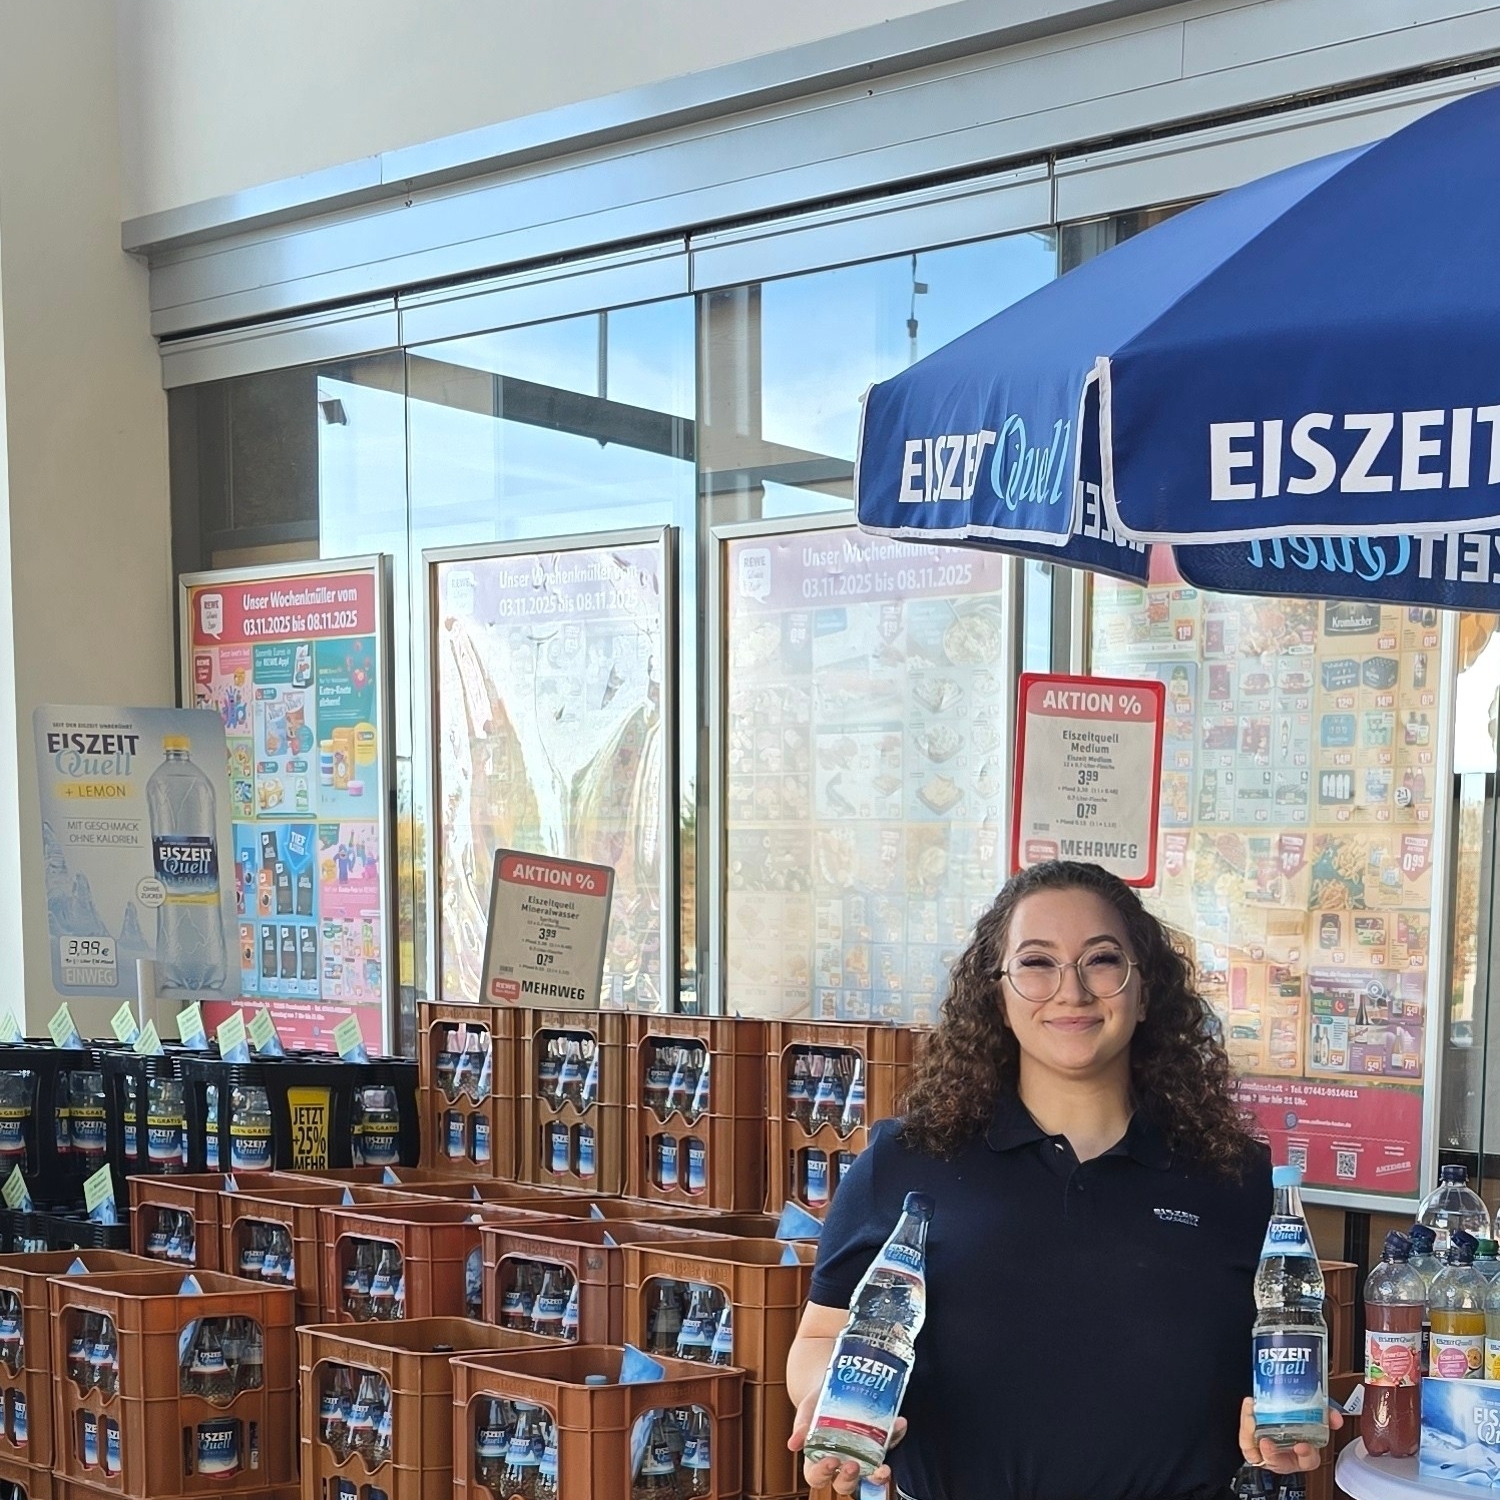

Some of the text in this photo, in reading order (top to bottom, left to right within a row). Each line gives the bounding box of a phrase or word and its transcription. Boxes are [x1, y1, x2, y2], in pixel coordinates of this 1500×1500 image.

[743, 555, 766, 567] REWE
[802, 547, 840, 567] Unser
[499, 571, 529, 589] Unser
[802, 564, 972, 598] 03.11.2025 bis 08.11.2025
[243, 586, 357, 610] Unser Wochenknüller vom
[499, 596, 556, 617] 03.11.2025
[576, 588, 637, 611] 08.11.2025
[243, 610, 357, 635] 03.11.2025 bis 08.11.2025
[1332, 615, 1373, 628] Krombacher
[1043, 690, 1141, 715] AKTION %
[47, 733, 139, 756] EISZEIT
[1062, 730, 1119, 744] Eiszeitquell
[1071, 742, 1110, 754] Medium
[55, 750, 133, 777] Quell
[1077, 770, 1099, 785] 3.99
[65, 785, 126, 797] + LEMON
[1076, 803, 1097, 819] 0.79
[67, 821, 138, 831] MIT GESCHMACK
[69, 834, 138, 844] OHNE KALORIEN
[159, 847, 212, 861] EISZEIT
[1060, 839, 1138, 859] MEHRWEG
[164, 856, 209, 875] Quell
[1403, 854, 1424, 871] 0.99
[512, 864, 595, 890] AKTION %
[141, 892, 163, 900] ZUCKER
[528, 896, 575, 910] Eiszeitquell
[521, 904, 579, 920] Mineralwasser
[69, 941, 109, 956] 3,99 €
[66, 969, 113, 985] EINWEG
[521, 980, 585, 1001] MEHRWEG
[293, 1107, 324, 1125] JETZT
[237, 1139, 267, 1149] EISZEIT
[293, 1126, 326, 1156] +25%
[239, 1146, 264, 1156] Quell
[1258, 1346, 1312, 1363] EISZEIT
[836, 1353, 898, 1382] EISZEIT
[840, 1384, 879, 1400] SPRITZIG
[198, 1430, 233, 1443] EISZEIT
[199, 1438, 231, 1452] Quell
